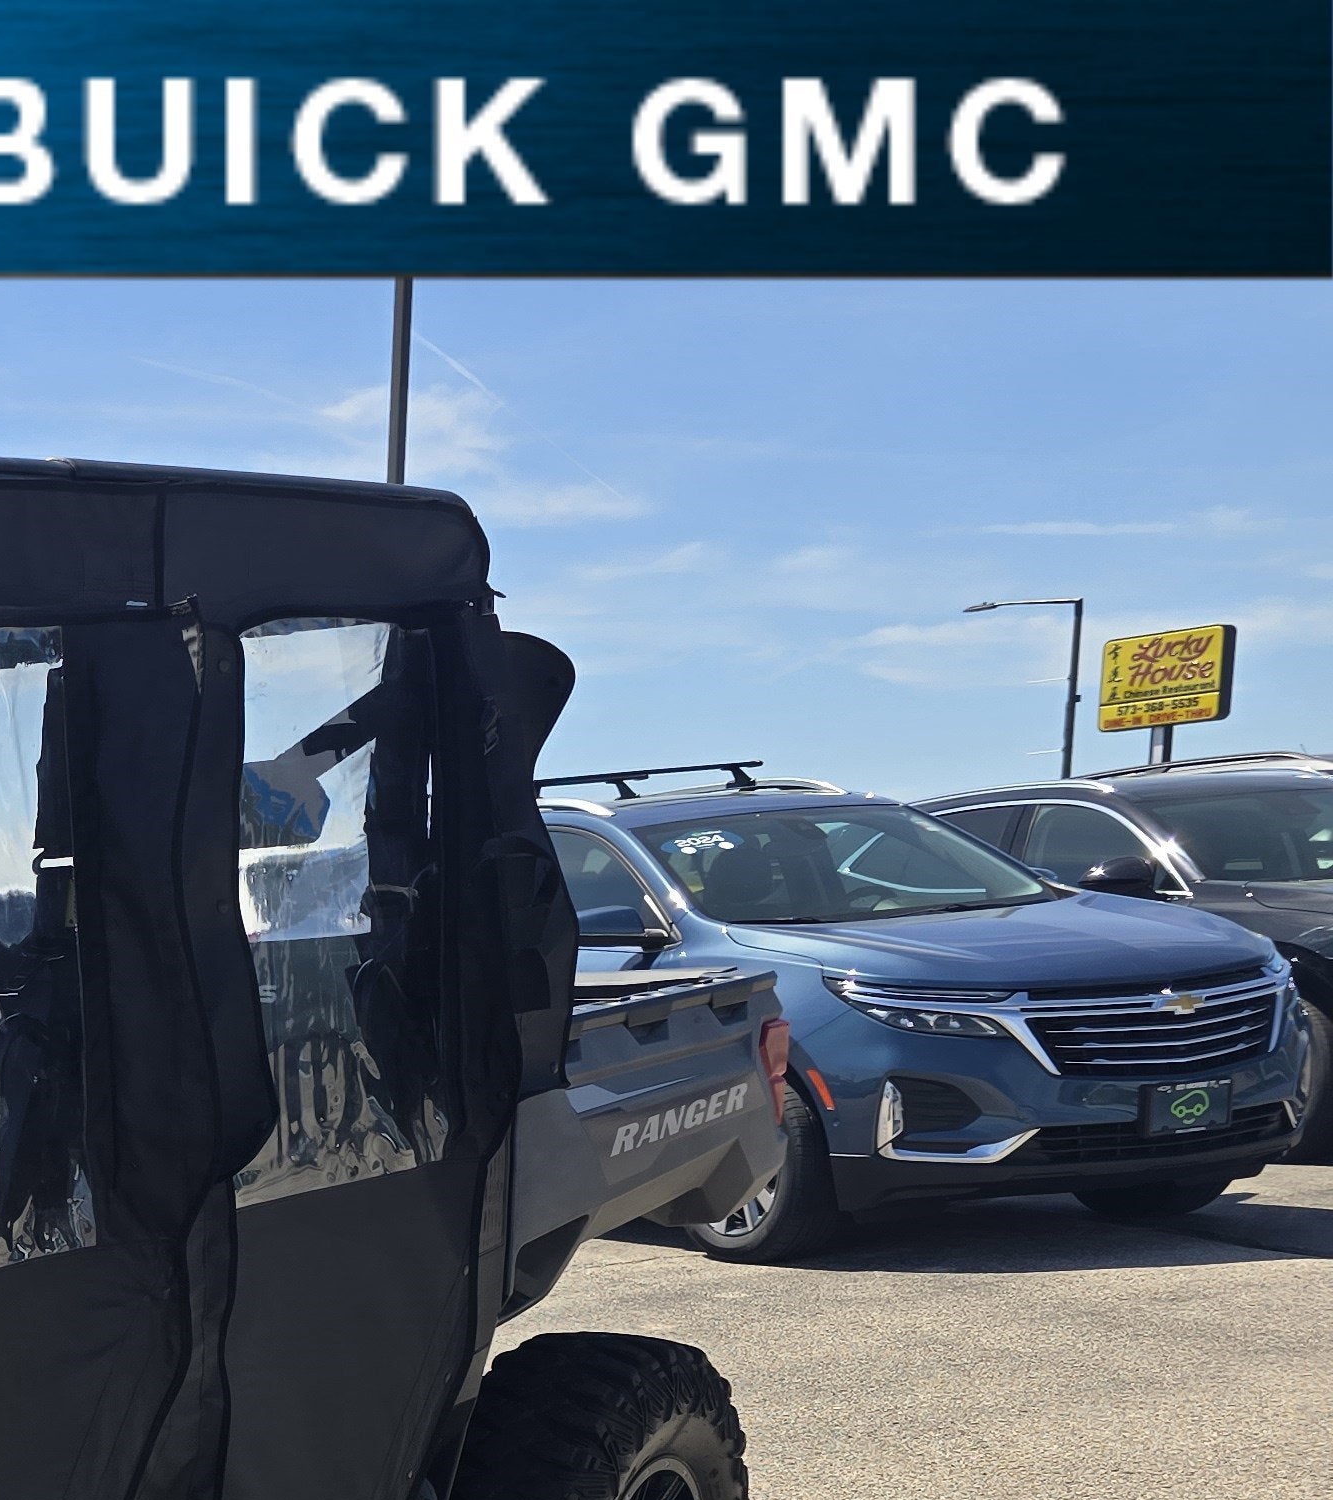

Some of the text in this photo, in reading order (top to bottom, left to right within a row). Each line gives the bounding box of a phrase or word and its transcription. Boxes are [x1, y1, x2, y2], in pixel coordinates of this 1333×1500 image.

[1130, 634, 1215, 663] Lucky
[1123, 680, 1215, 700] Chinese Restaurant
[674, 834, 726, 848] 2024
[609, 1083, 748, 1158] RANGER
